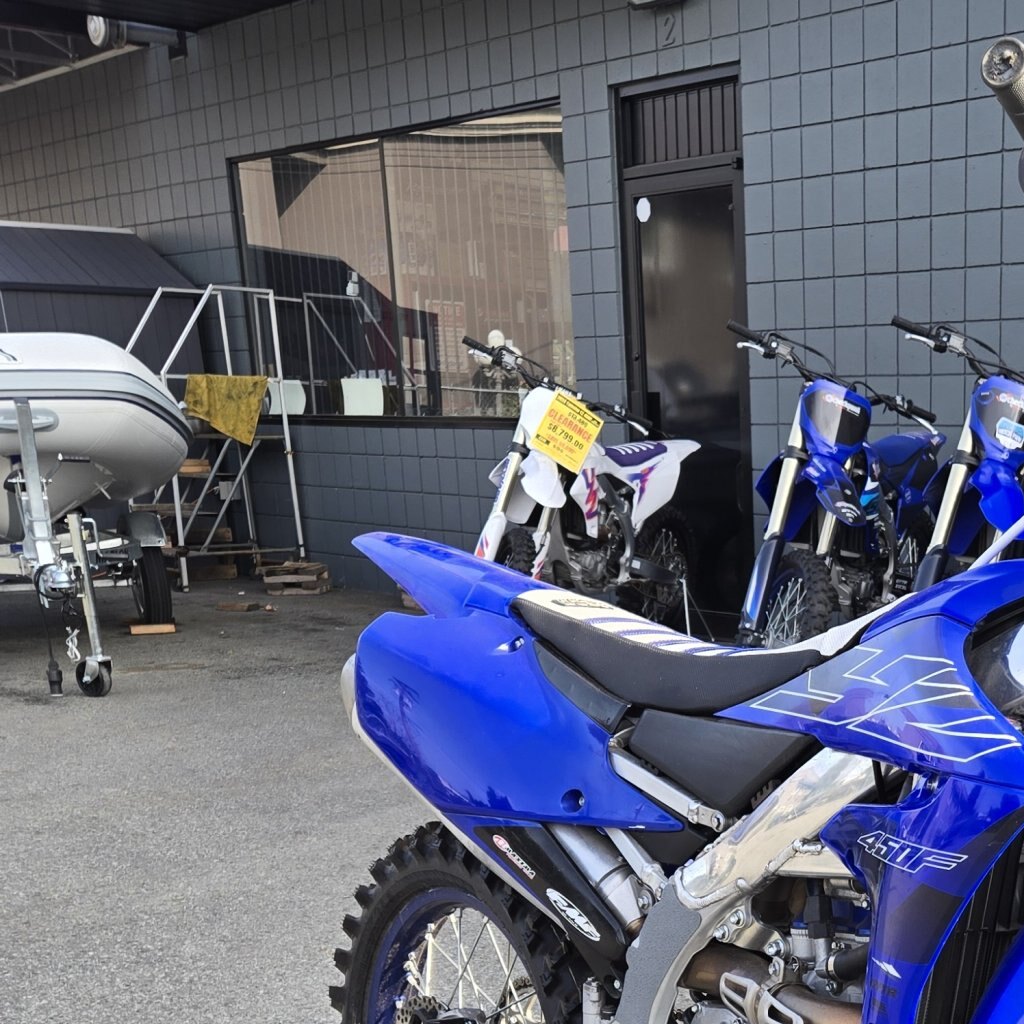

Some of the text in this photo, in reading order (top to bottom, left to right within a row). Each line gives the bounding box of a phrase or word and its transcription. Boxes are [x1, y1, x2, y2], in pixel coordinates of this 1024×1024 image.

[662, 13, 677, 48] 2
[548, 408, 593, 443] CLEARANCE
[857, 830, 969, 874] 450F
